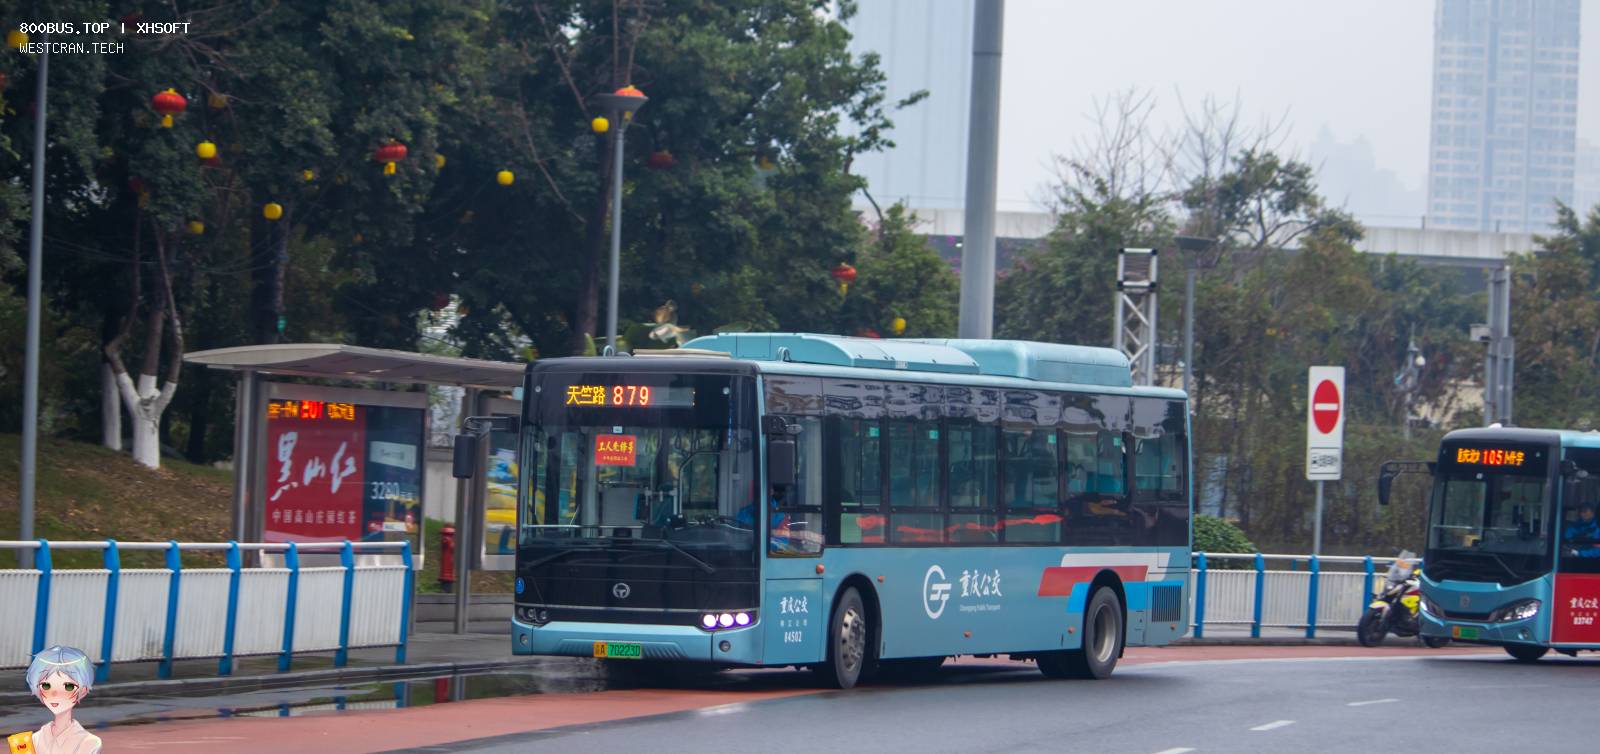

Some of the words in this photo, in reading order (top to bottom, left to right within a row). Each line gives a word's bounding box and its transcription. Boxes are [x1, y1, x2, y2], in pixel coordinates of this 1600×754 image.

[566, 385, 606, 405] 天竺路
[612, 385, 650, 406] 879
[1483, 448, 1504, 465] 105
[960, 569, 1002, 598] 重庆公交
[780, 595, 808, 615] 重庆公交
[1570, 597, 1598, 609] 重庆公交
